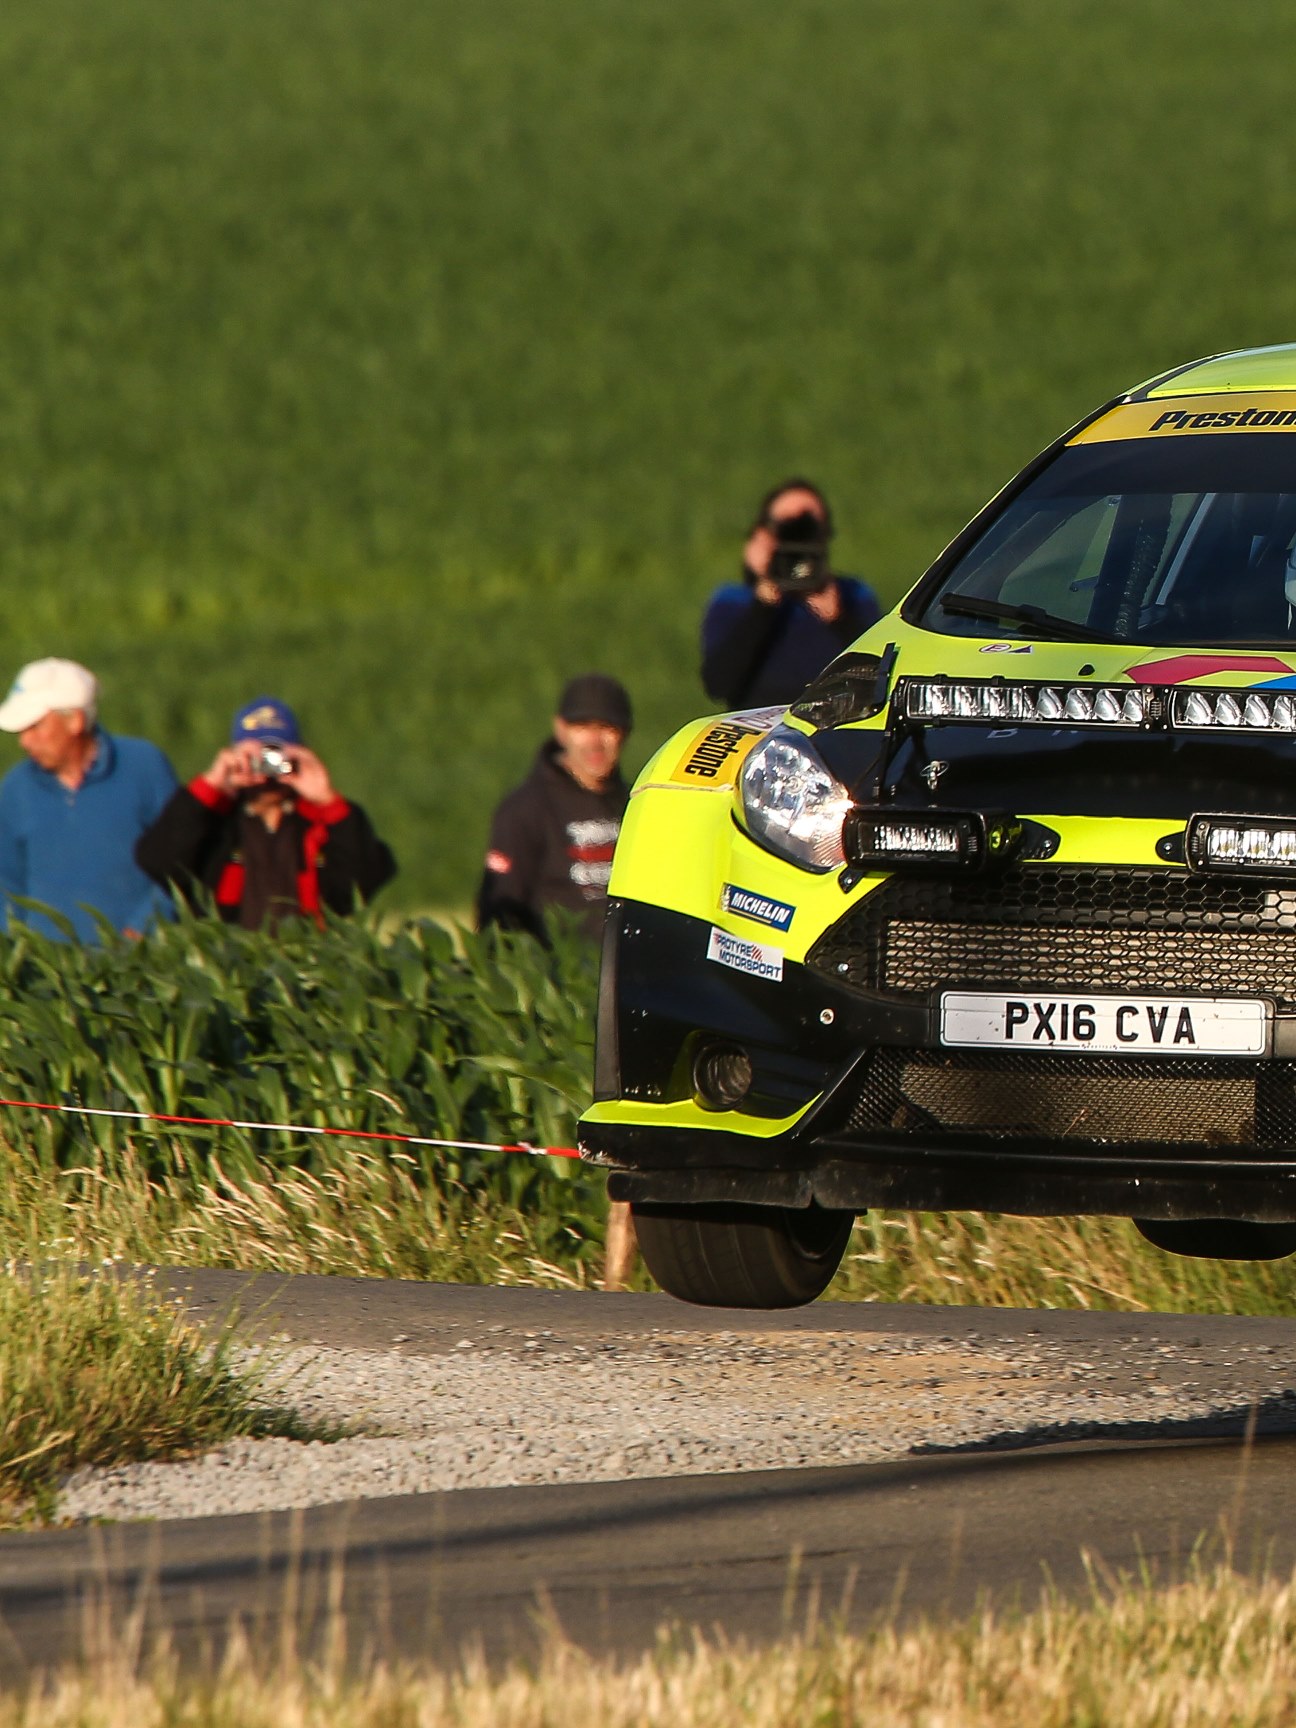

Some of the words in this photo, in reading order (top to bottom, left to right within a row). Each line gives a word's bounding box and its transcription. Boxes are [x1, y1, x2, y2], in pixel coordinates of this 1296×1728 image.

[731, 892, 791, 923] MICHELIN
[717, 935, 754, 957] PROTYRE
[719, 949, 782, 978] MOTORSPORT
[1004, 1001, 1096, 1041] PX16
[1116, 1005, 1196, 1044] CVA
